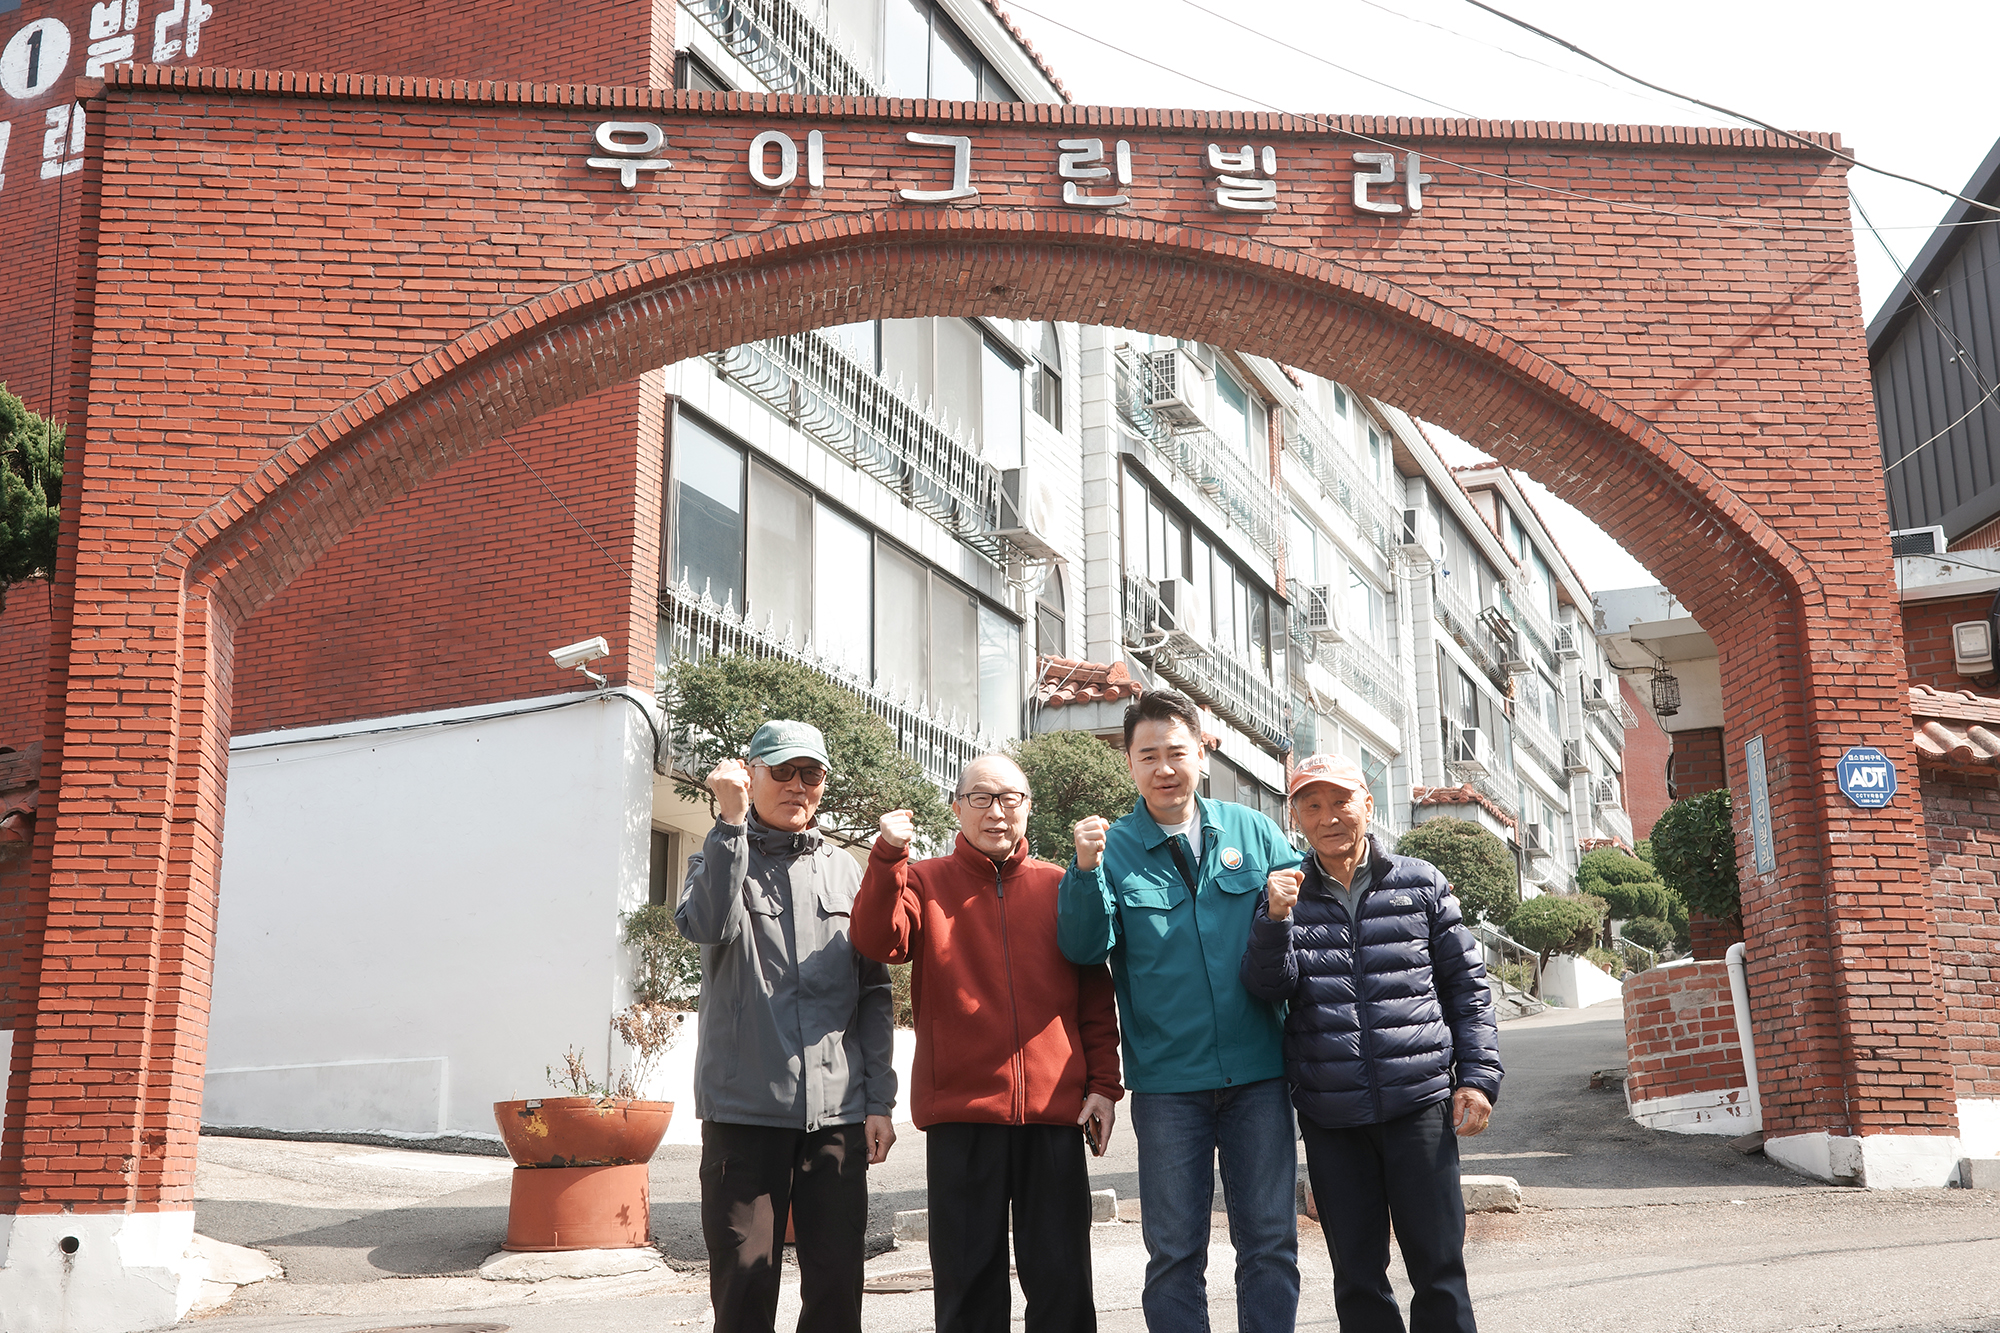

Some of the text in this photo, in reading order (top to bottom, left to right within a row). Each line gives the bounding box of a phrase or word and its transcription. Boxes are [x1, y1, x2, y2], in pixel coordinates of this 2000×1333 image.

[586, 121, 1433, 214] 우이그린빌라
[1751, 742, 1773, 869] 우이그린빌라
[1849, 766, 1886, 788] ADT
